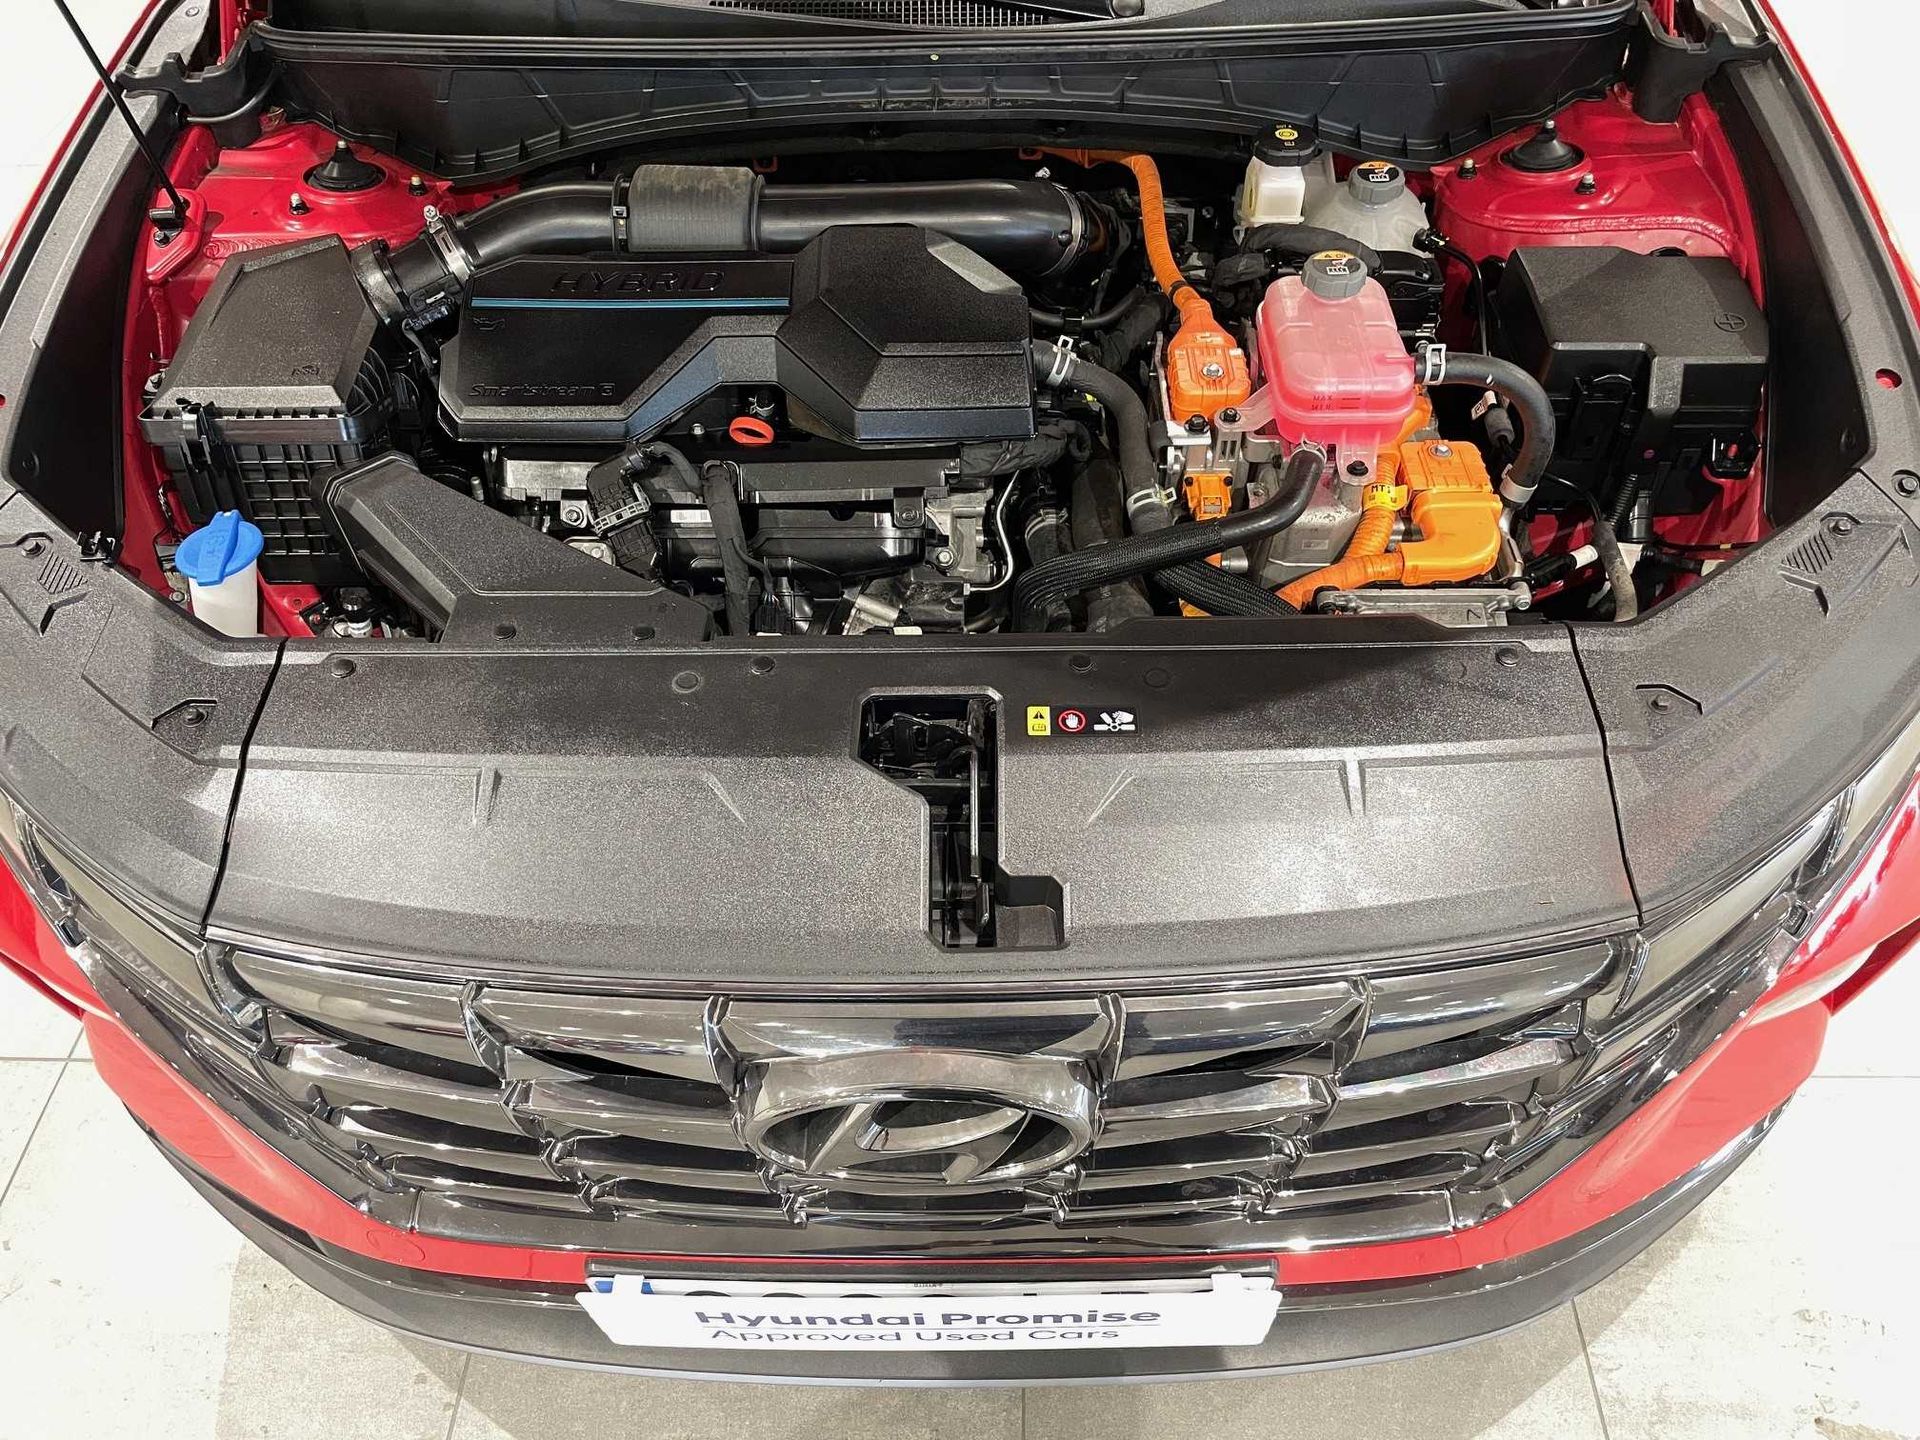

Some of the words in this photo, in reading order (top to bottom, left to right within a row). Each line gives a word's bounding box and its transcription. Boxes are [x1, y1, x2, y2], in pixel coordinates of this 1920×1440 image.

[550, 270, 725, 293] HYBRID
[469, 383, 596, 397] Smartstream
[694, 1311, 925, 1327] Hyundai
[941, 1309, 1161, 1325] Promise
[711, 1330, 901, 1342] Approved
[916, 1330, 1015, 1341] Used
[1028, 1329, 1119, 1340] Cars
